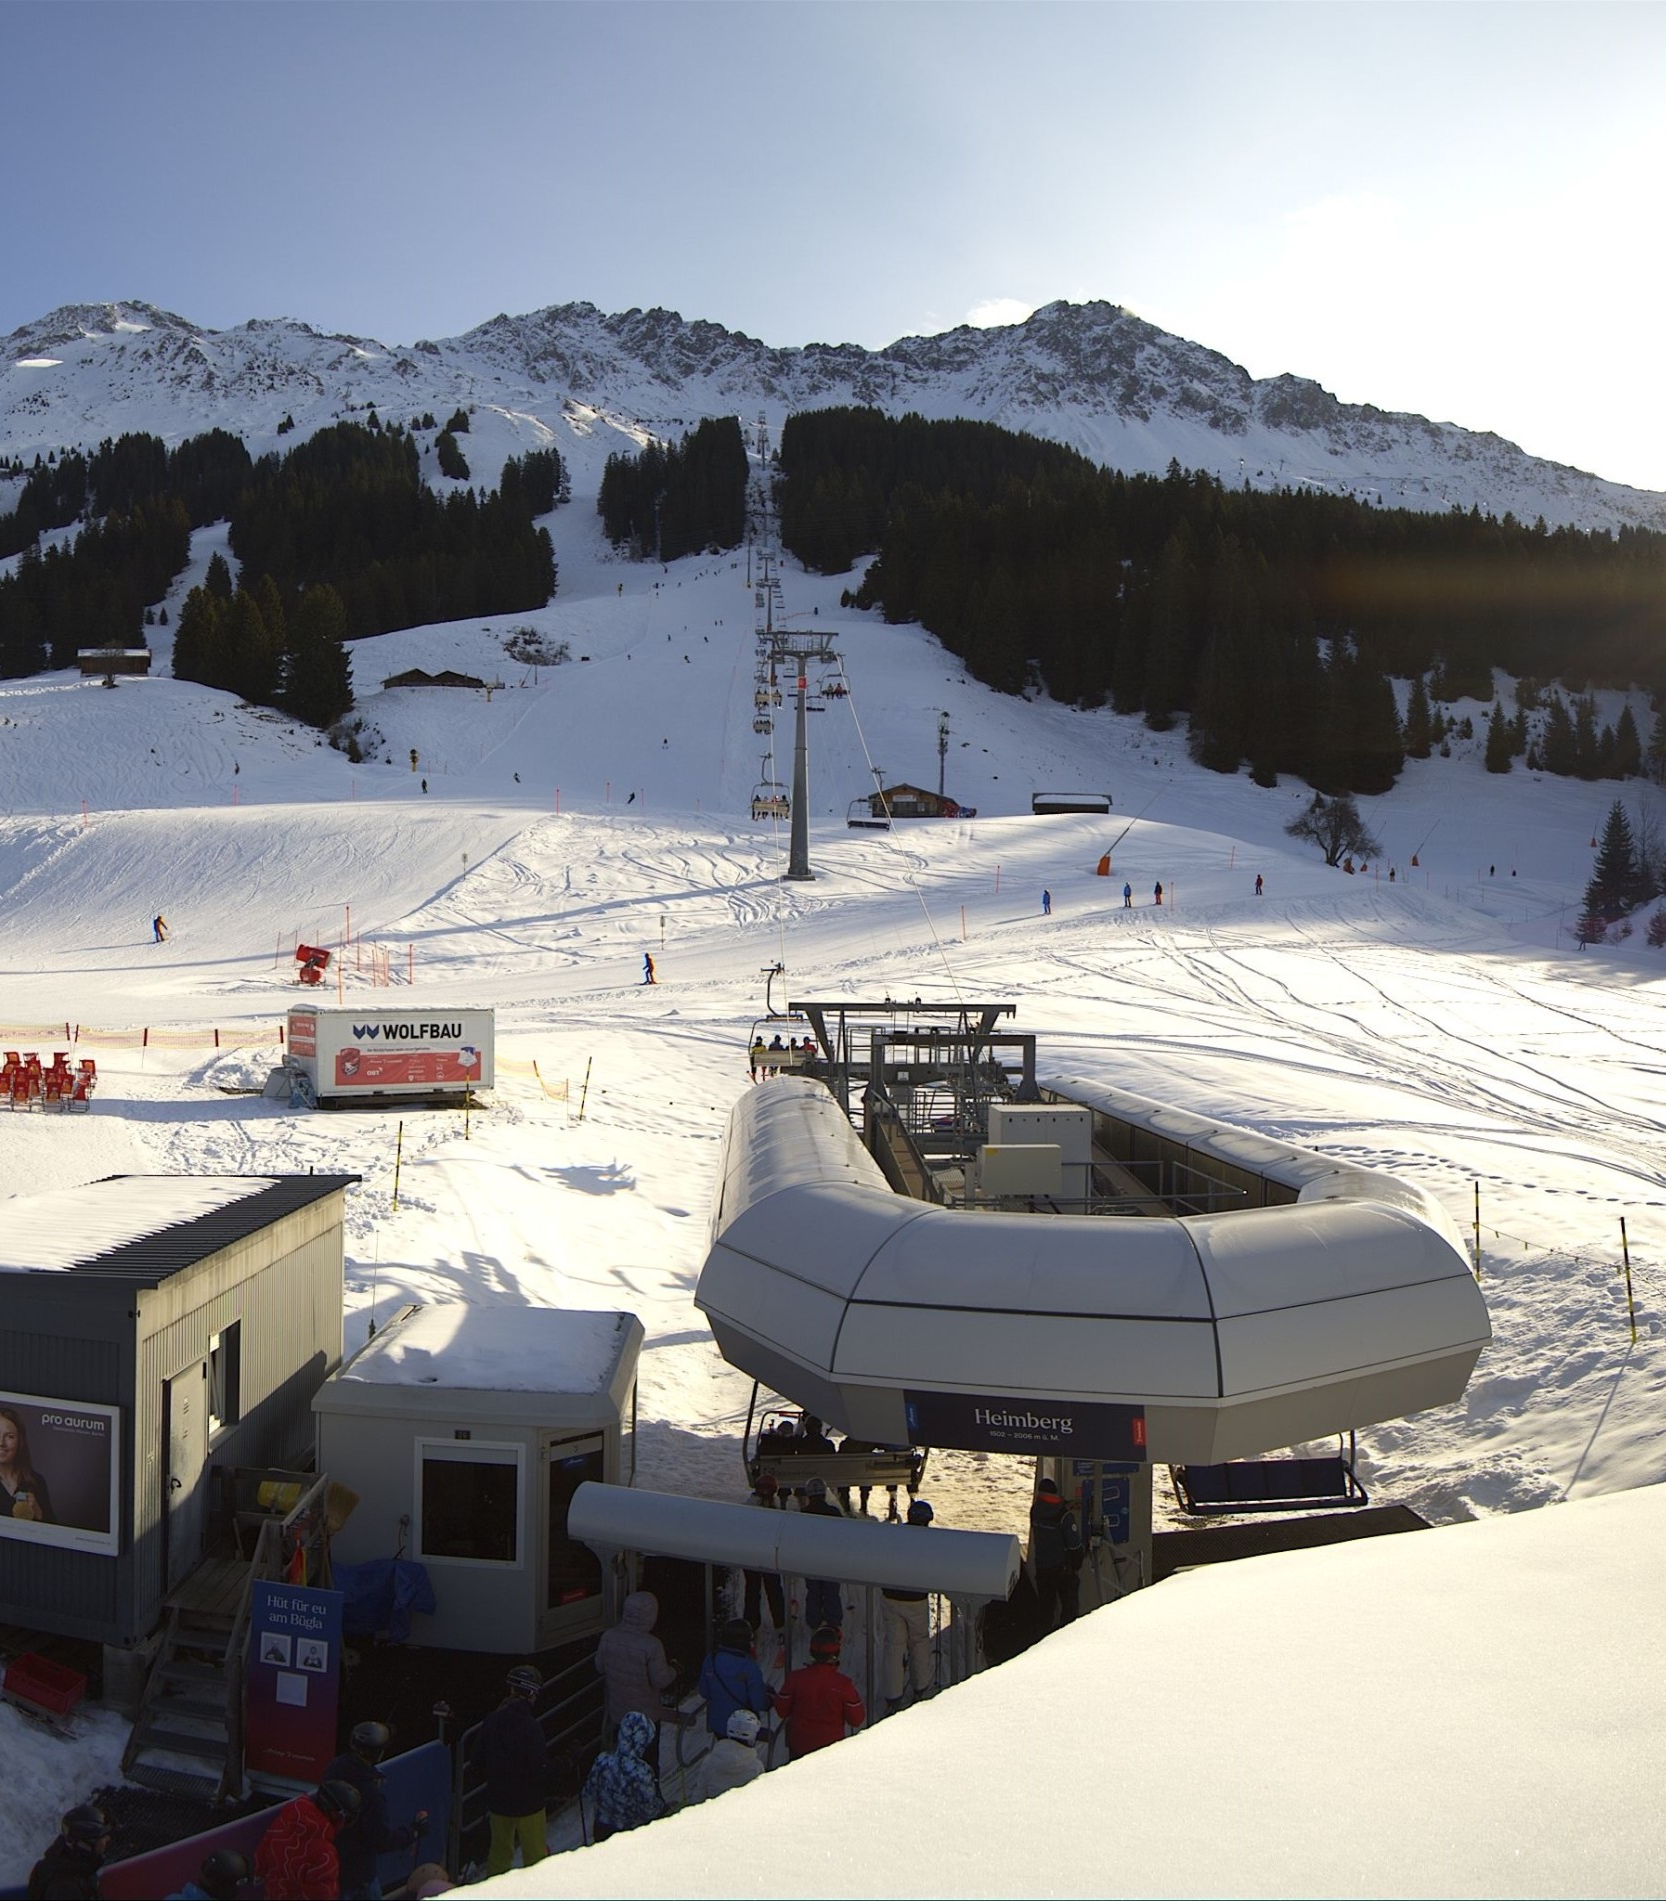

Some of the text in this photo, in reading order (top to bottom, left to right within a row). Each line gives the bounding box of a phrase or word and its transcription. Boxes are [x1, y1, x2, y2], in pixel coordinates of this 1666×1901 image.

[383, 1023, 462, 1040] WOLFBAU
[41, 1414, 63, 1426] pro
[64, 1417, 105, 1431] aurum
[974, 1408, 1073, 1434] Heimberg
[267, 1594, 326, 1616] Hüt für eu
[269, 1612, 323, 1630] am Bügla
